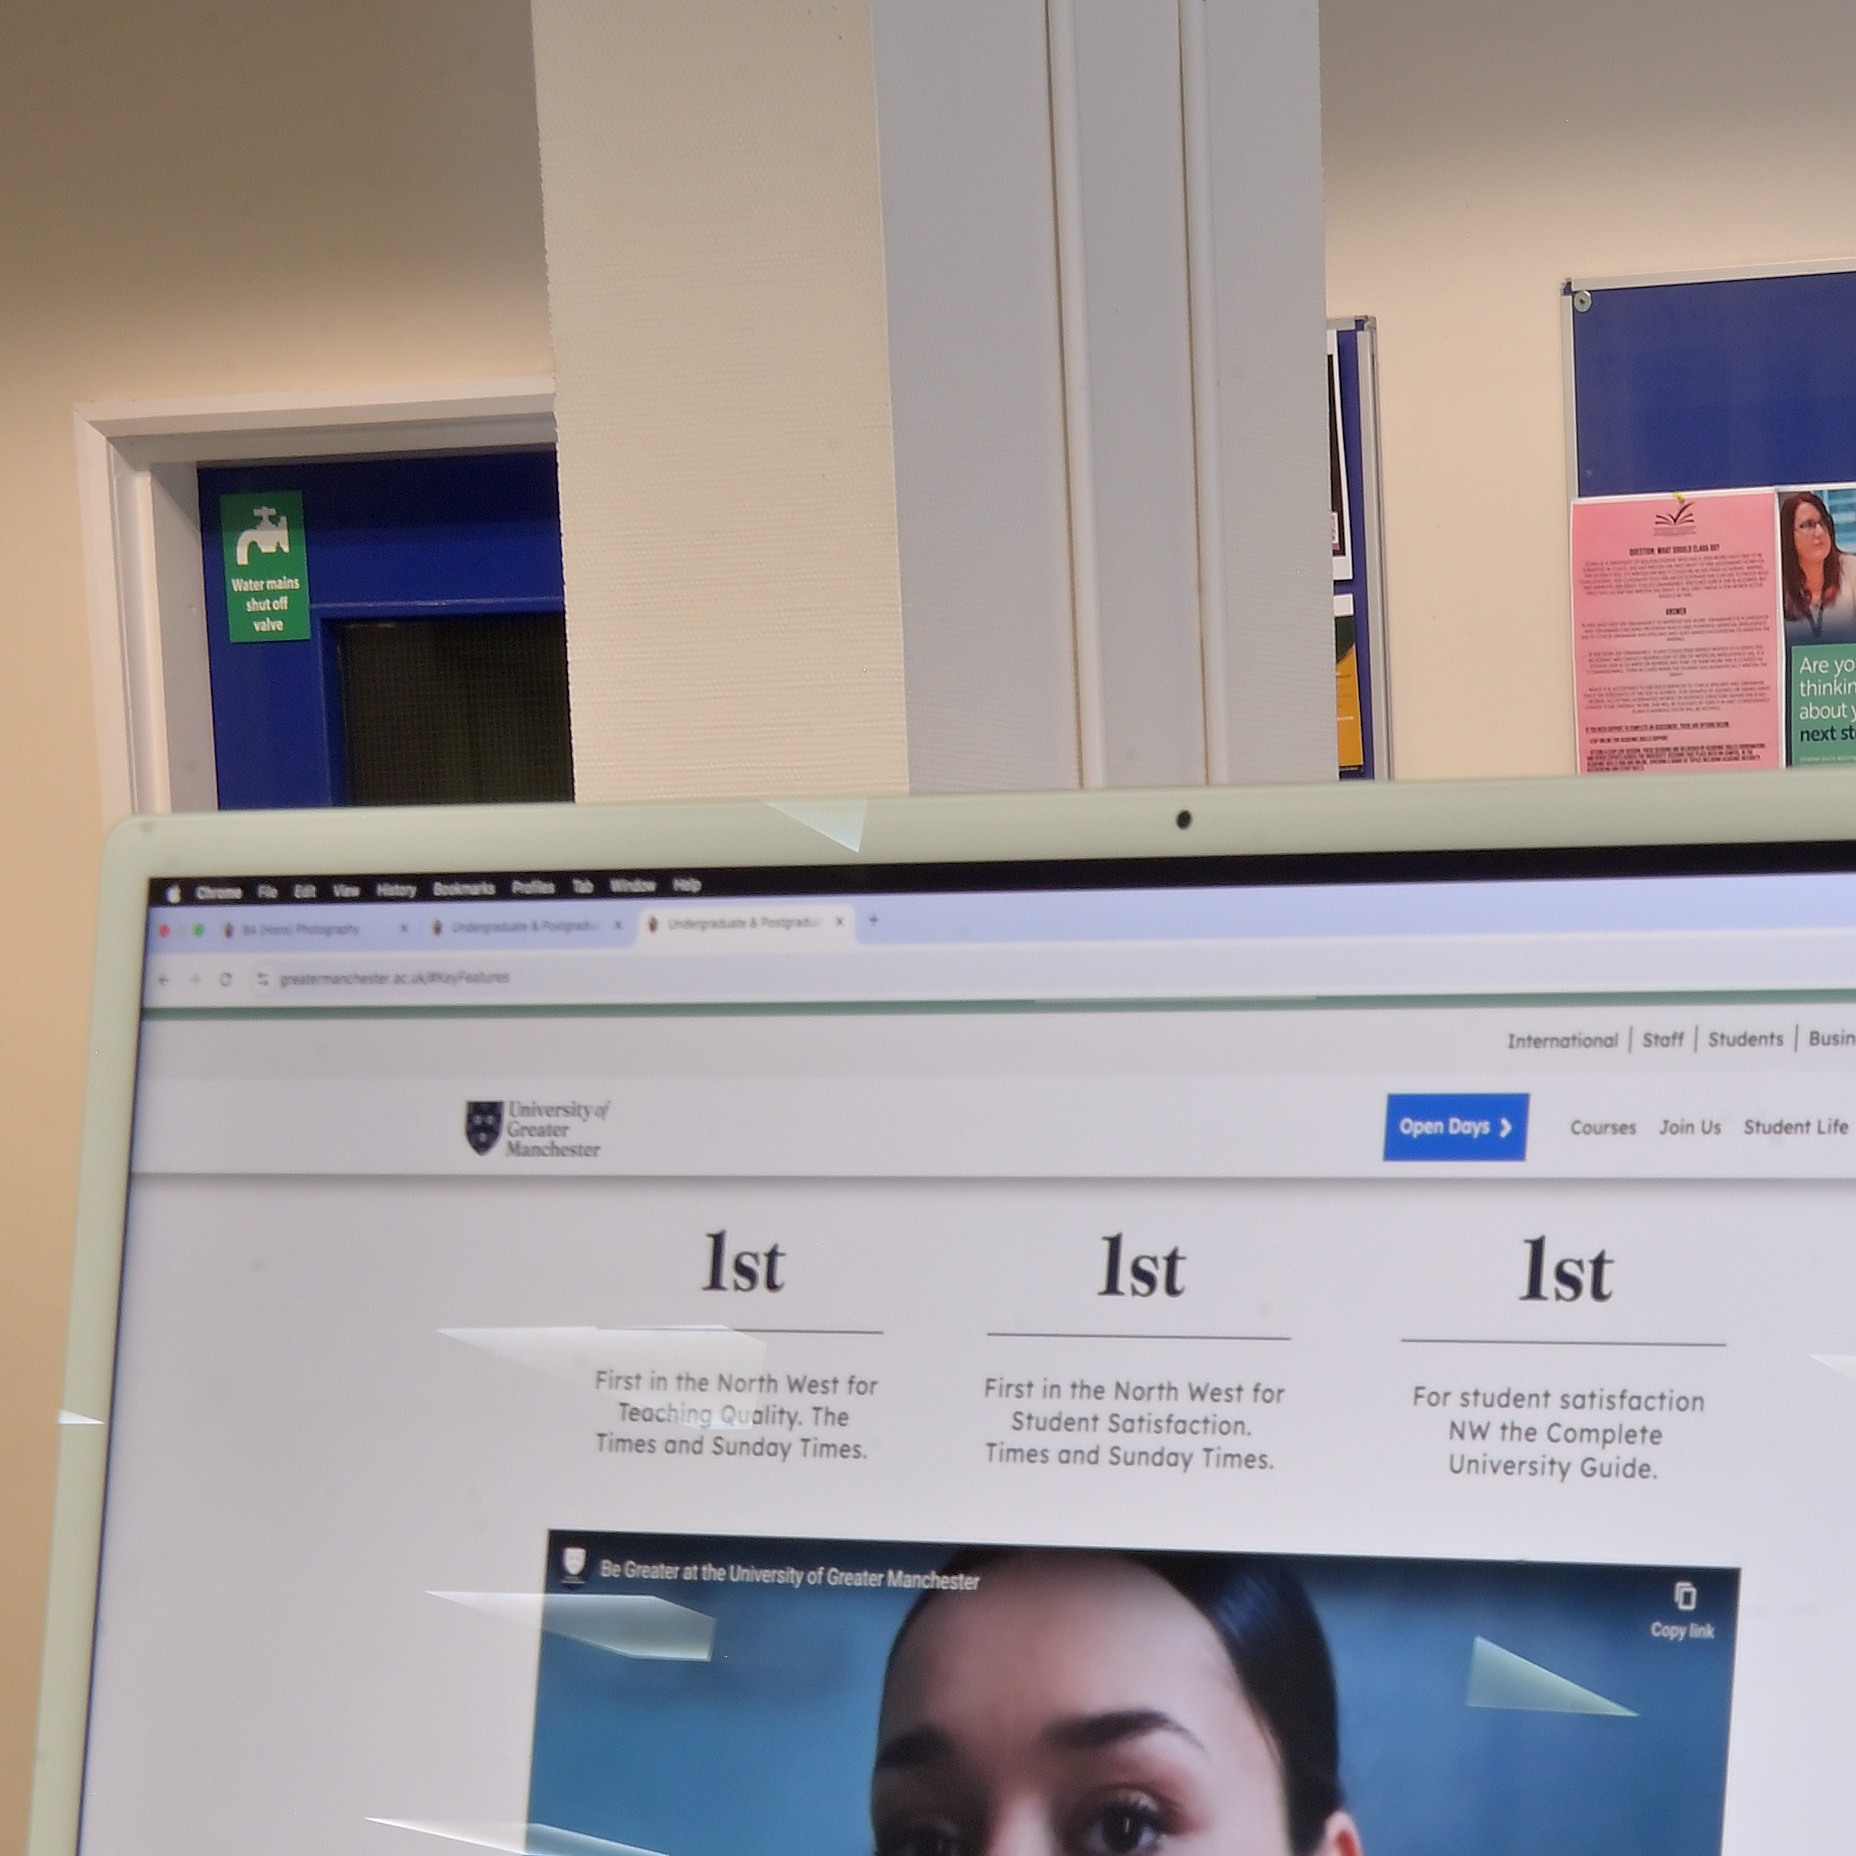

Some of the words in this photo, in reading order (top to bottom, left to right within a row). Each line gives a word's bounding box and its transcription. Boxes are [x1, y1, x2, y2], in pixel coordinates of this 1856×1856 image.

[231, 578, 264, 592] Water
[266, 575, 300, 590] mains
[246, 597, 271, 612] shut
[272, 595, 288, 610] off
[253, 617, 284, 632] valve
[1800, 657, 1829, 674] Are
[1799, 702, 1847, 720] about
[1800, 724, 1837, 742] next
[195, 886, 244, 900] Chrome
[257, 884, 278, 899] File
[294, 883, 317, 898] Edit
[332, 883, 360, 898] View
[376, 883, 418, 899] History
[432, 880, 497, 896] Bookmarks
[511, 879, 556, 896] Profiles
[572, 878, 594, 895] Tab
[609, 877, 657, 894] Window
[672, 876, 702, 894] Help
[1507, 1030, 1619, 1050] International
[1642, 1030, 1685, 1049] Staff
[1708, 1029, 1784, 1048] Students
[509, 1100, 591, 1122] University
[594, 1100, 611, 1121] of
[507, 1120, 570, 1138] Greater
[1399, 1117, 1446, 1139] Open
[1448, 1117, 1491, 1139] Days
[1570, 1119, 1637, 1137] Courses
[1658, 1119, 1697, 1137] Join
[1700, 1119, 1722, 1137] Us
[1743, 1118, 1812, 1136] Student
[1817, 1118, 1849, 1136] Life
[506, 1139, 602, 1158] Manchester
[701, 1229, 786, 1294] 1st
[1097, 1231, 1188, 1299] 1st
[1519, 1234, 1615, 1303] 1st
[595, 1370, 642, 1391] First
[649, 1370, 668, 1391] in
[676, 1371, 709, 1392] the
[717, 1373, 778, 1393] North
[786, 1374, 840, 1394] West
[847, 1375, 878, 1395] for
[984, 1377, 1034, 1400] First
[1042, 1377, 1061, 1400] in
[1070, 1379, 1105, 1401] the
[1113, 1380, 1180, 1402] North
[1188, 1381, 1245, 1403] West
[1252, 1382, 1286, 1404] for
[1412, 1386, 1452, 1407] For
[1459, 1387, 1551, 1409] student
[1560, 1388, 1705, 1412] satisfaction
[618, 1402, 712, 1428] Teaching
[720, 1404, 802, 1431] Quality.
[811, 1406, 850, 1426] The
[1011, 1411, 1100, 1433] Student
[1107, 1413, 1252, 1436] Satisfaction.
[1449, 1421, 1491, 1441] NW
[1499, 1421, 1538, 1442] the
[1546, 1422, 1663, 1449] Complete
[596, 1433, 657, 1454] Times
[664, 1436, 704, 1455] and
[711, 1436, 792, 1462] Sunday
[800, 1438, 867, 1460] Times.
[985, 1443, 1050, 1464] Times
[1058, 1445, 1100, 1465] and
[1108, 1446, 1194, 1473] Sunday
[1202, 1447, 1274, 1470] Times.
[1449, 1453, 1572, 1482] University
[1580, 1457, 1658, 1480] Guide.
[601, 1559, 620, 1577] Be
[624, 1560, 680, 1580] Greater
[683, 1562, 699, 1581] at
[701, 1563, 726, 1582] the
[729, 1564, 804, 1588] University
[808, 1567, 824, 1585] of
[827, 1567, 883, 1588] Greater
[887, 1568, 981, 1591] Manchester
[1650, 1621, 1687, 1641] Copy
[1689, 1622, 1715, 1639] link
